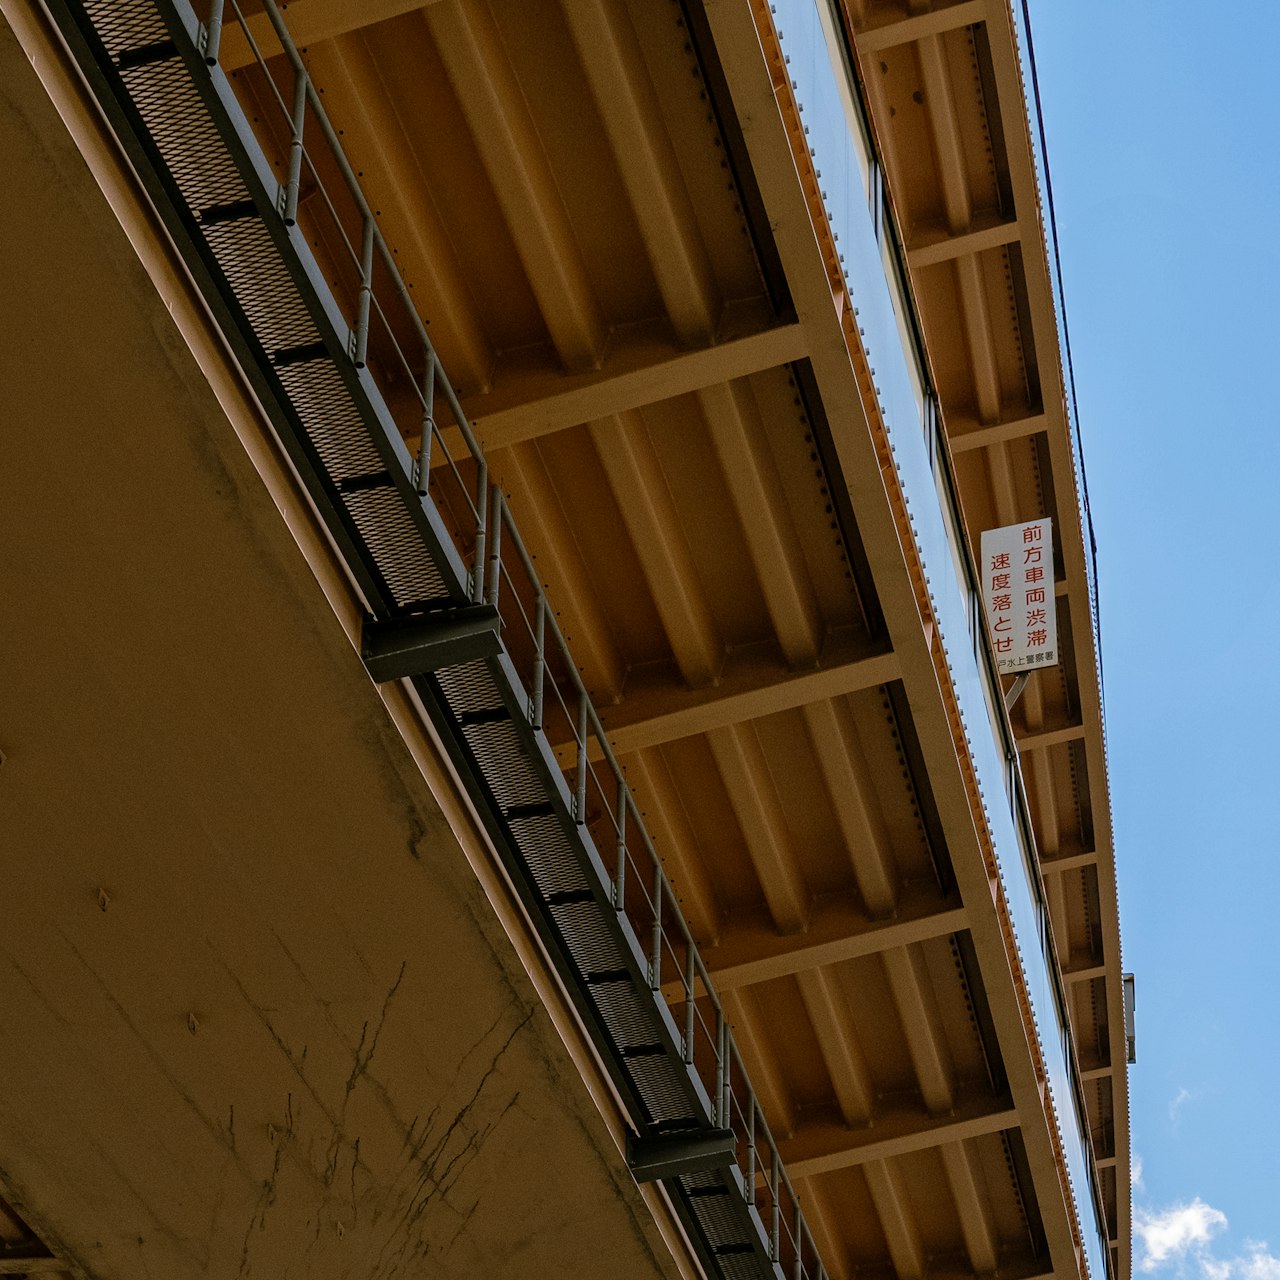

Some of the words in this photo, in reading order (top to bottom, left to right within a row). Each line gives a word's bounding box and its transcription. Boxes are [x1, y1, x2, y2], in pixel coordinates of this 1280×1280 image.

[990, 553, 1014, 653] 速度落とせ
[1022, 525, 1047, 648] 前方車両渋滞
